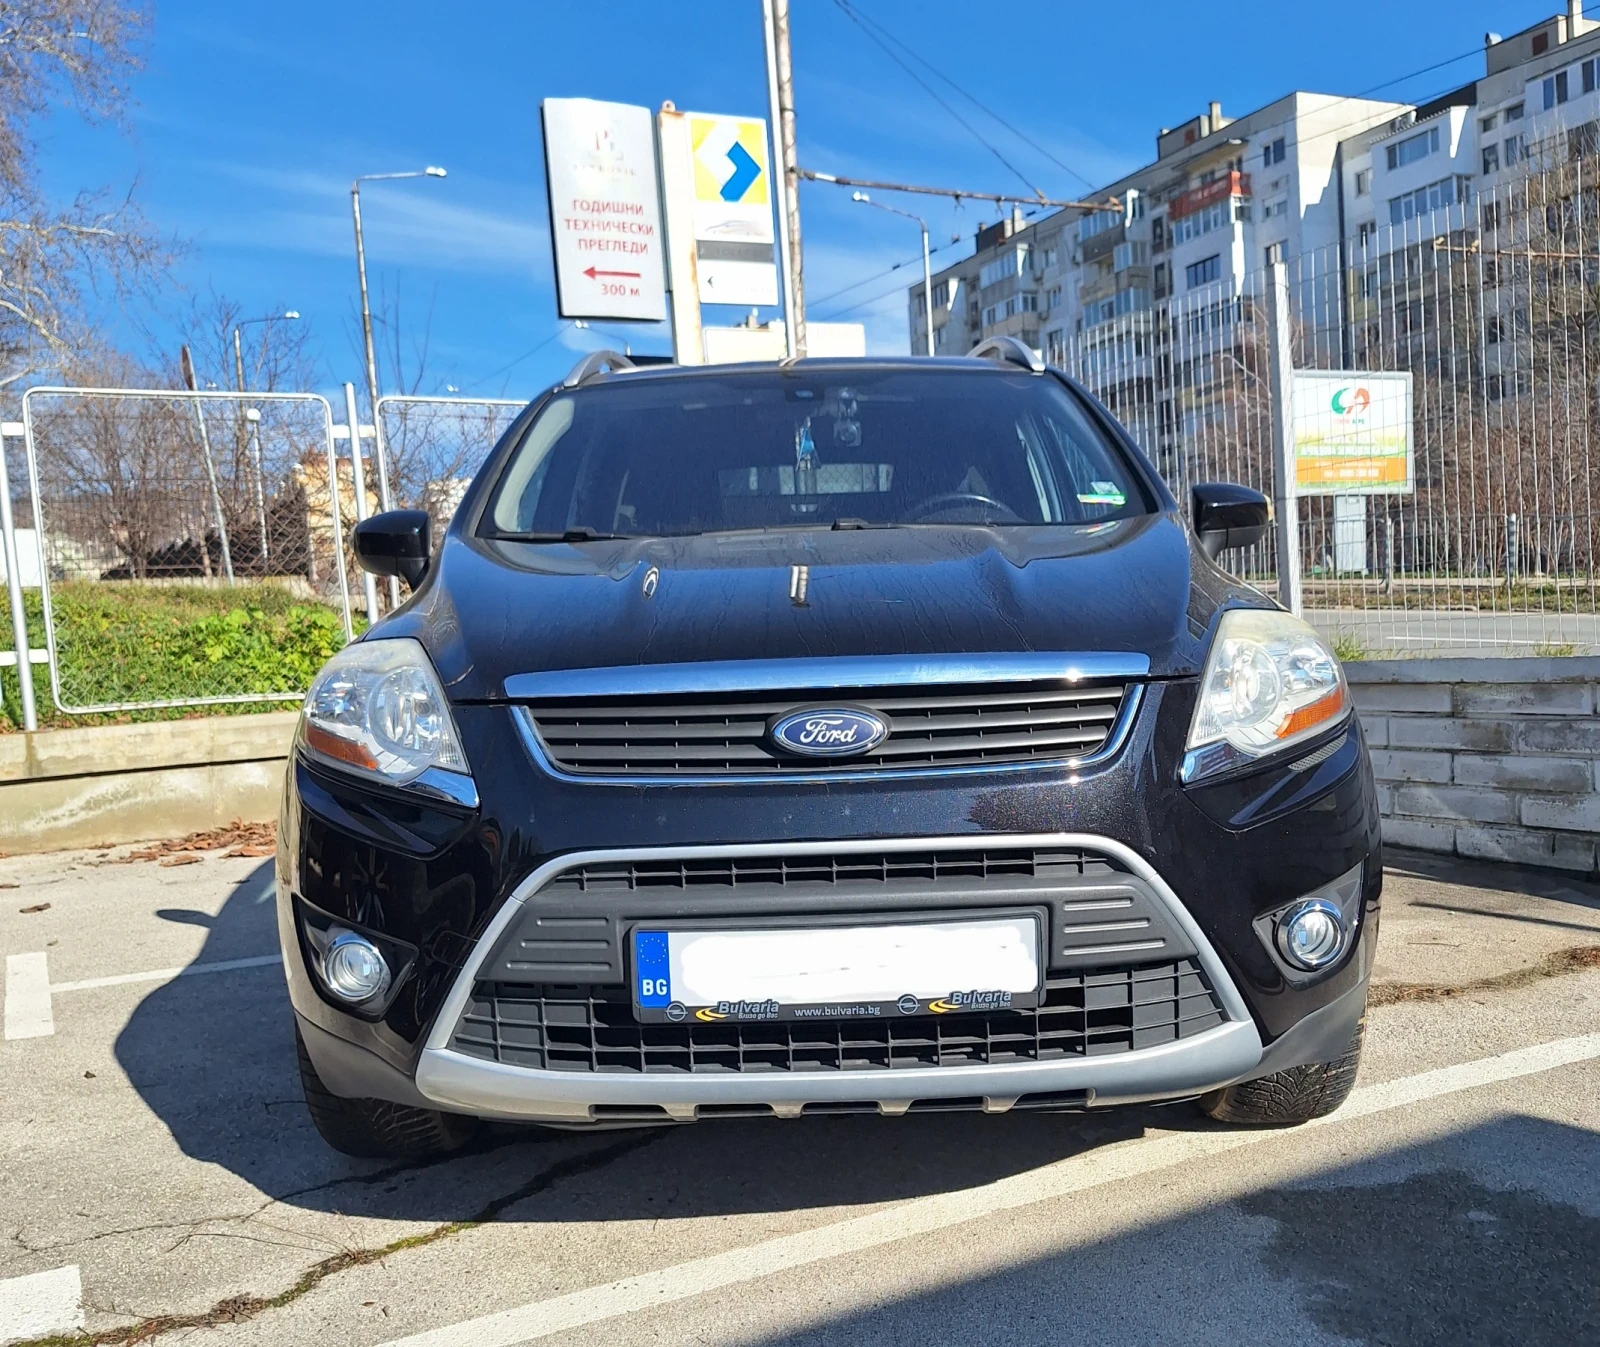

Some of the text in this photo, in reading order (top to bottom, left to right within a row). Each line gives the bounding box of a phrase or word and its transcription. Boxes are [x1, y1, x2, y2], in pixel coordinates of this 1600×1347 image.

[573, 199, 644, 216] ГОДИШНИ
[565, 218, 654, 236] ТЕХНИЧЕСКИ
[578, 238, 649, 254] ПРЕГЛЕДИ
[601, 283, 626, 296] 300
[800, 719, 858, 743] Ford
[642, 978, 667, 996] BG
[952, 990, 1012, 1004] Bulvaria
[719, 1000, 779, 1014] Bulvaria
[794, 1005, 881, 1017] www.bulvaria.bg
